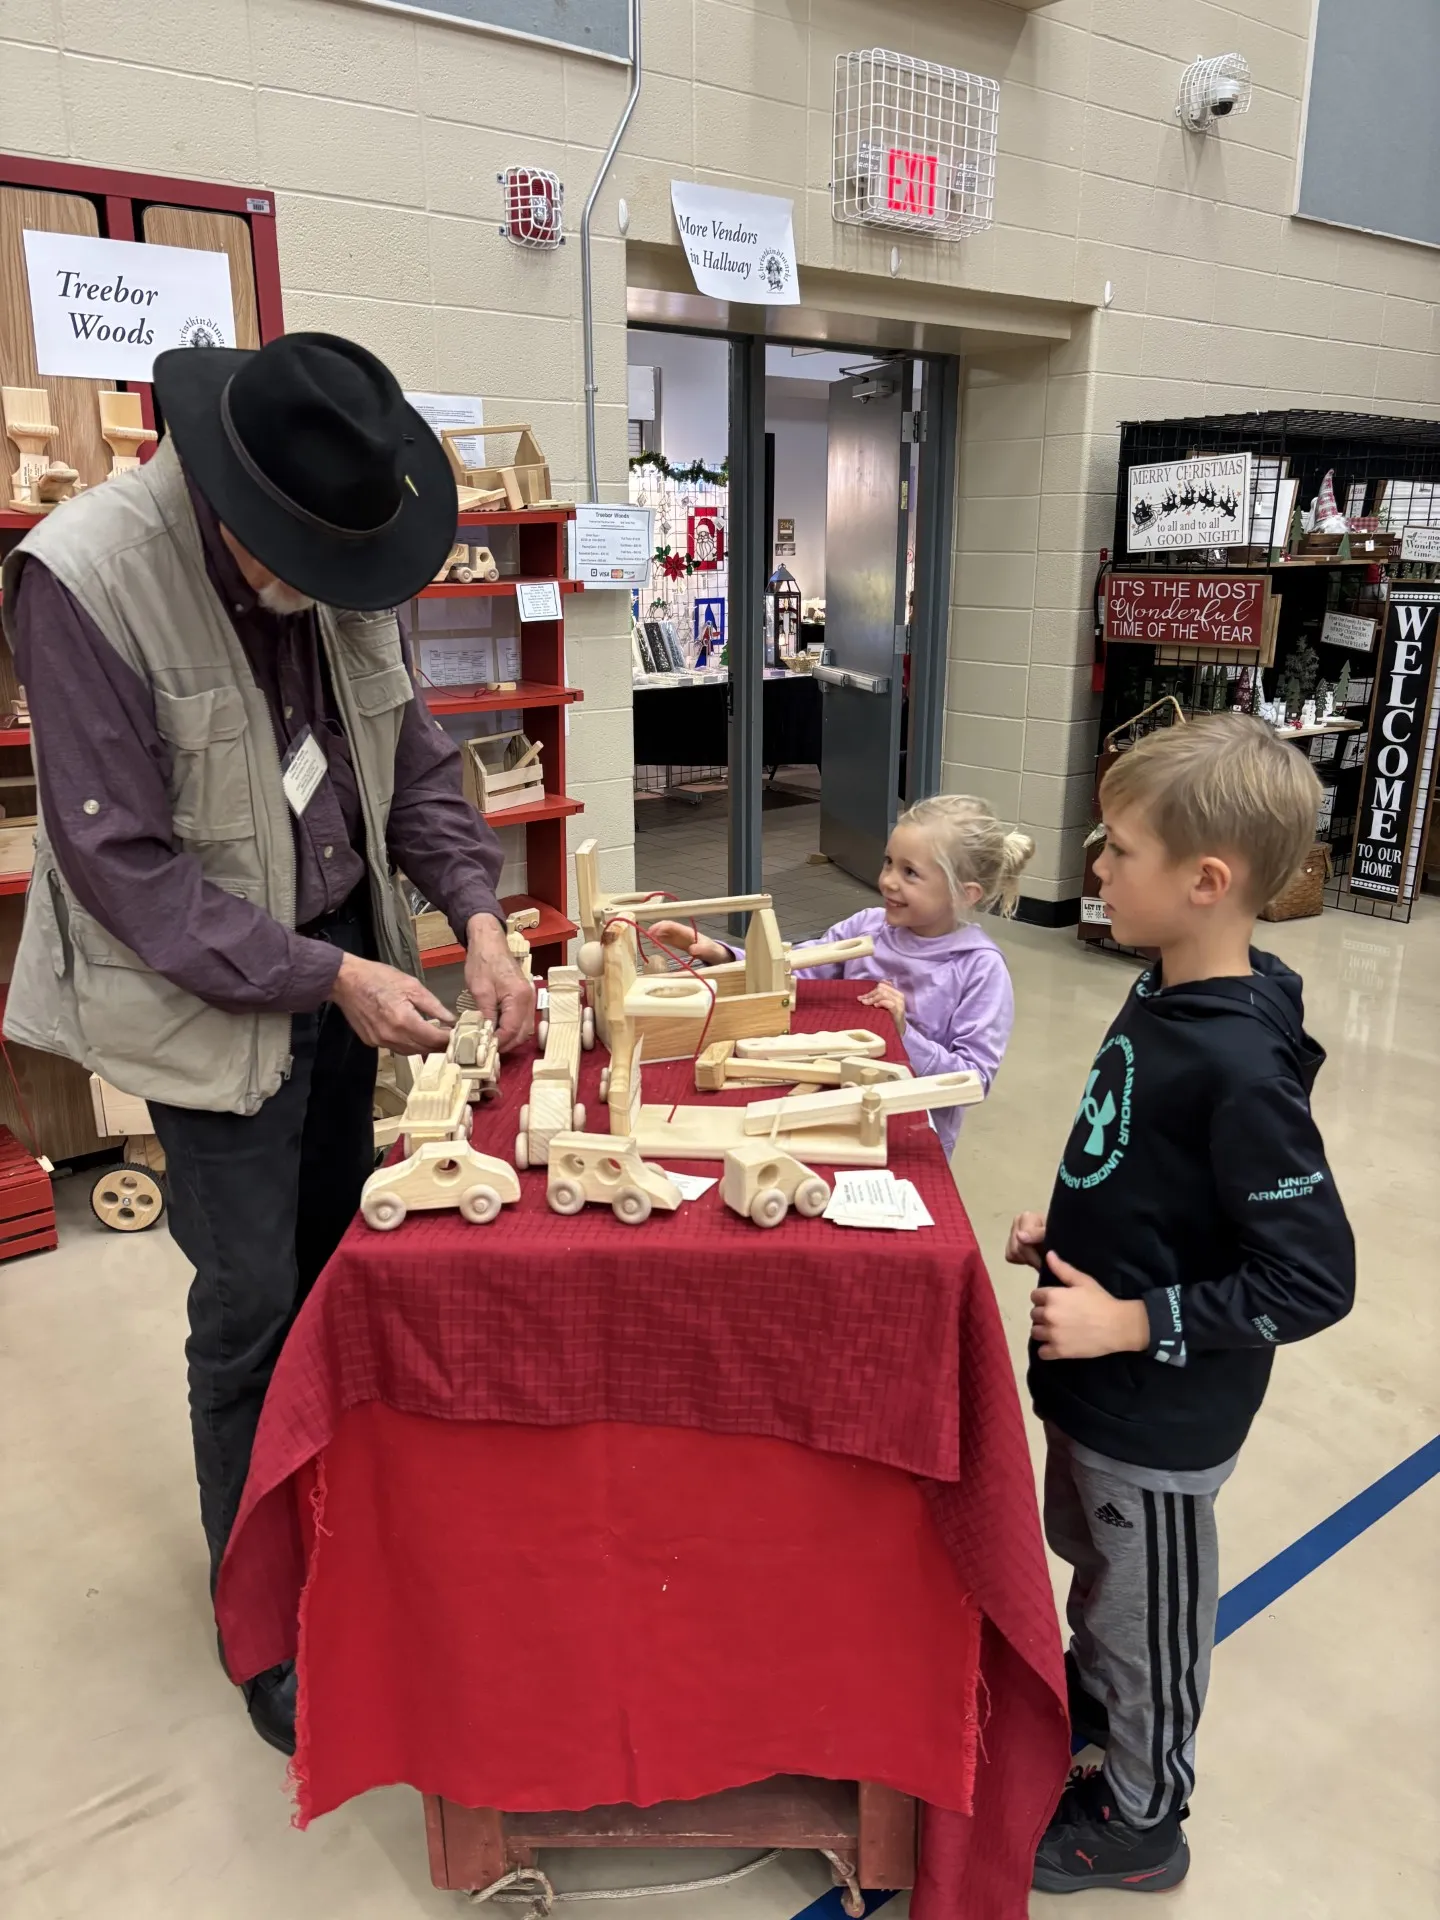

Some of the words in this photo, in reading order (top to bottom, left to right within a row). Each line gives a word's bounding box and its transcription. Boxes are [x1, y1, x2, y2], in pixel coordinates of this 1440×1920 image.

[887, 148, 938, 216] EXIT
[678, 214, 708, 238] More
[711, 220, 758, 245] Vendors
[689, 248, 700, 265] in
[702, 250, 752, 280] Hallway
[56, 269, 159, 306] Treebor
[67, 311, 155, 345] Woods
[1132, 467, 1171, 486] MERRY
[1176, 459, 1243, 481] CHRISTMAS
[1143, 536, 1152, 547] A
[1157, 533, 1193, 546] GOOD
[1198, 529, 1240, 543] NIGHT
[1157, 523, 1165, 533] to
[1167, 521, 1178, 532] all
[1179, 519, 1196, 531] and
[1198, 520, 1207, 530] to
[1207, 518, 1220, 529] all
[1112, 580, 1145, 597] IT'S
[1150, 581, 1191, 598] THE
[1197, 582, 1261, 600] MOST
[1110, 597, 1254, 632] Wonderful
[1111, 620, 1143, 637] TIME
[1147, 622, 1167, 638] OF
[1170, 623, 1198, 640] THE
[1211, 624, 1253, 642] YEAR
[1366, 605, 1436, 844] WELCOME
[1357, 843, 1373, 859] TO
[1378, 847, 1402, 864] OUR
[1360, 859, 1393, 879] HOME
[1084, 903, 1095, 911] LET
[1114, 1034, 1135, 1066] UNDER
[1117, 1067, 1135, 1146] ARMOUR
[1082, 1149, 1124, 1189] UNDER
[1277, 1171, 1324, 1188] UNDER
[1247, 1185, 1314, 1201] ARMOUR
[1094, 1510, 1134, 1529] adidas
